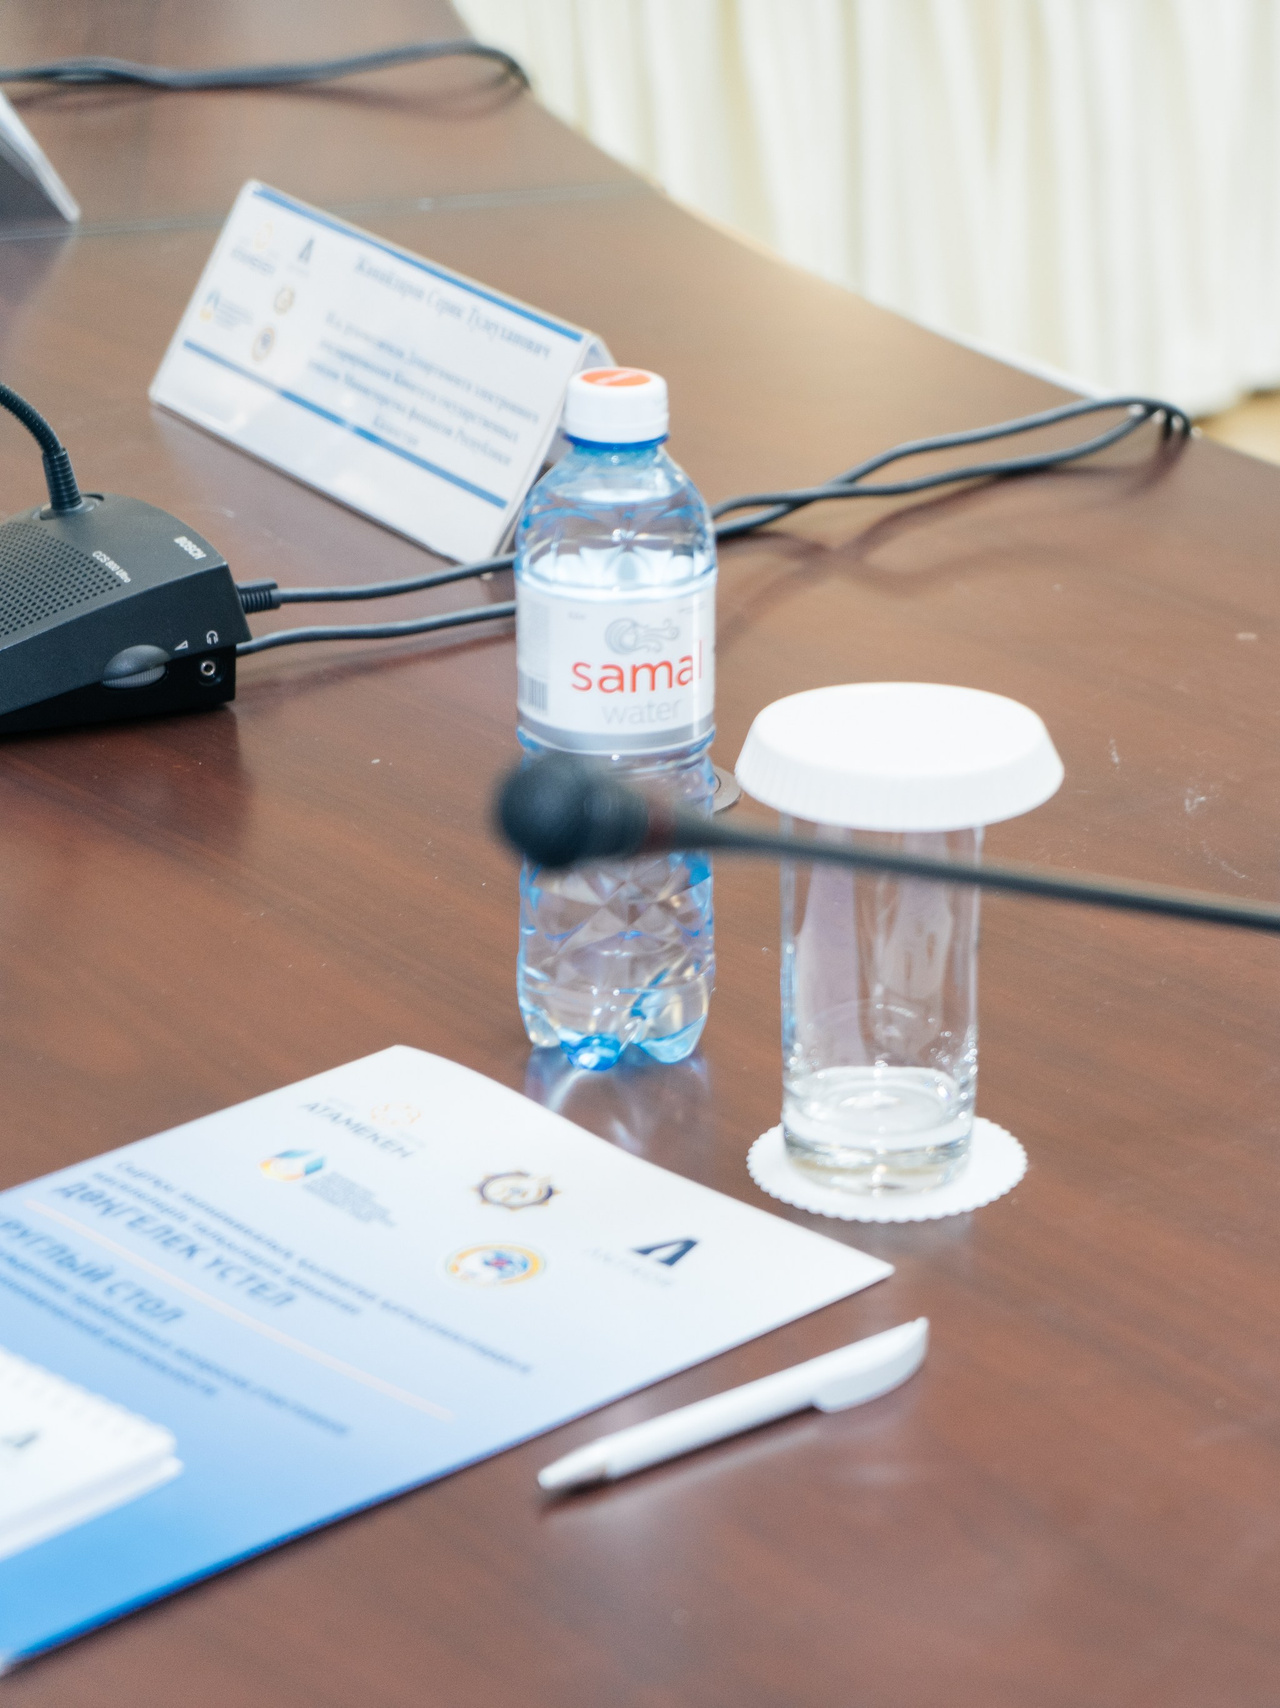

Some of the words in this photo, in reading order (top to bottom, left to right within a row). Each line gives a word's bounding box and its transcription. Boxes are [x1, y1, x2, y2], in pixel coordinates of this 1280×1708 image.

[571, 639, 702, 693] samal
[601, 699, 682, 725] water
[0, 1218, 115, 1283] РУГЛЫЙ
